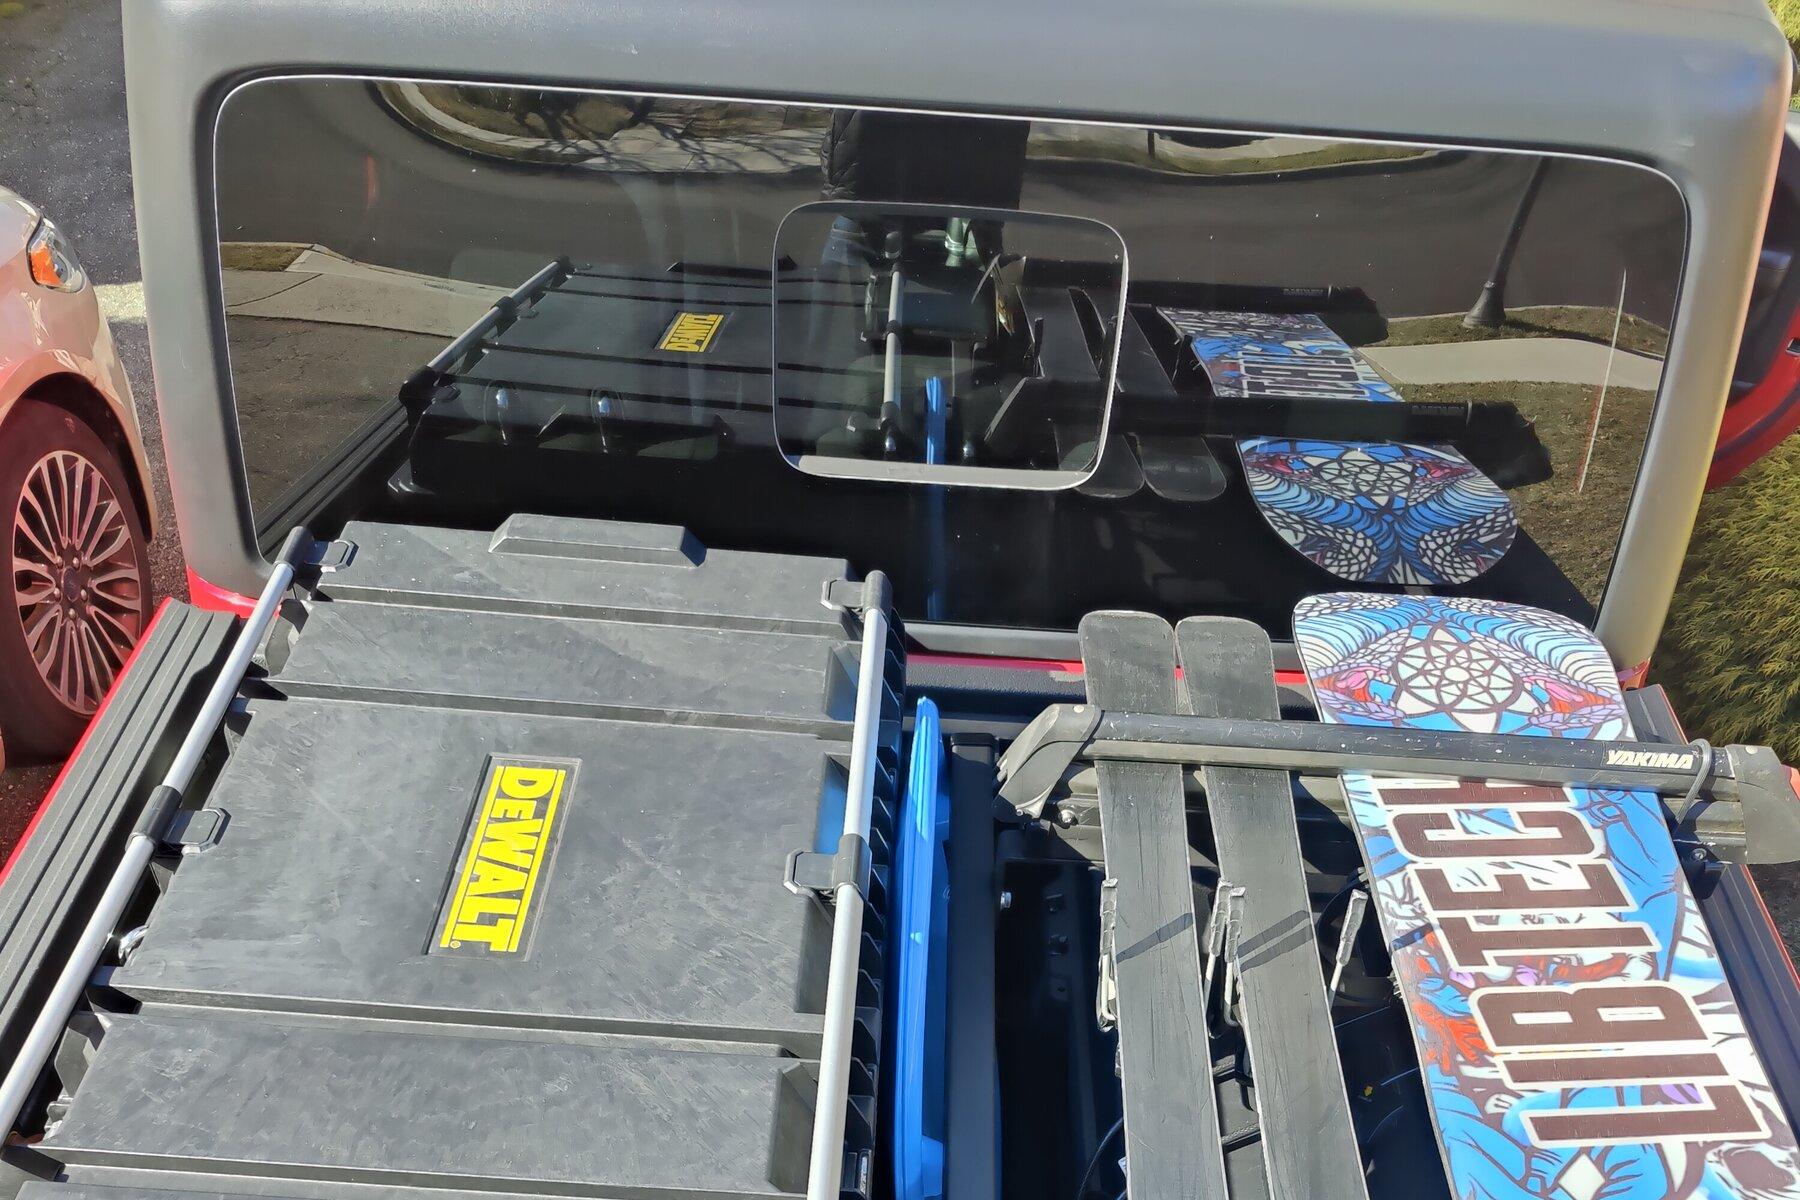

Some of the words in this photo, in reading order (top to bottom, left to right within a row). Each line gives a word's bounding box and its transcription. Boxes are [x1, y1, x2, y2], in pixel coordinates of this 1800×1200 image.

[1606, 750, 1694, 770] YAKIMA
[451, 765, 558, 952] DEWALT
[1474, 984, 1767, 1144] LIB
